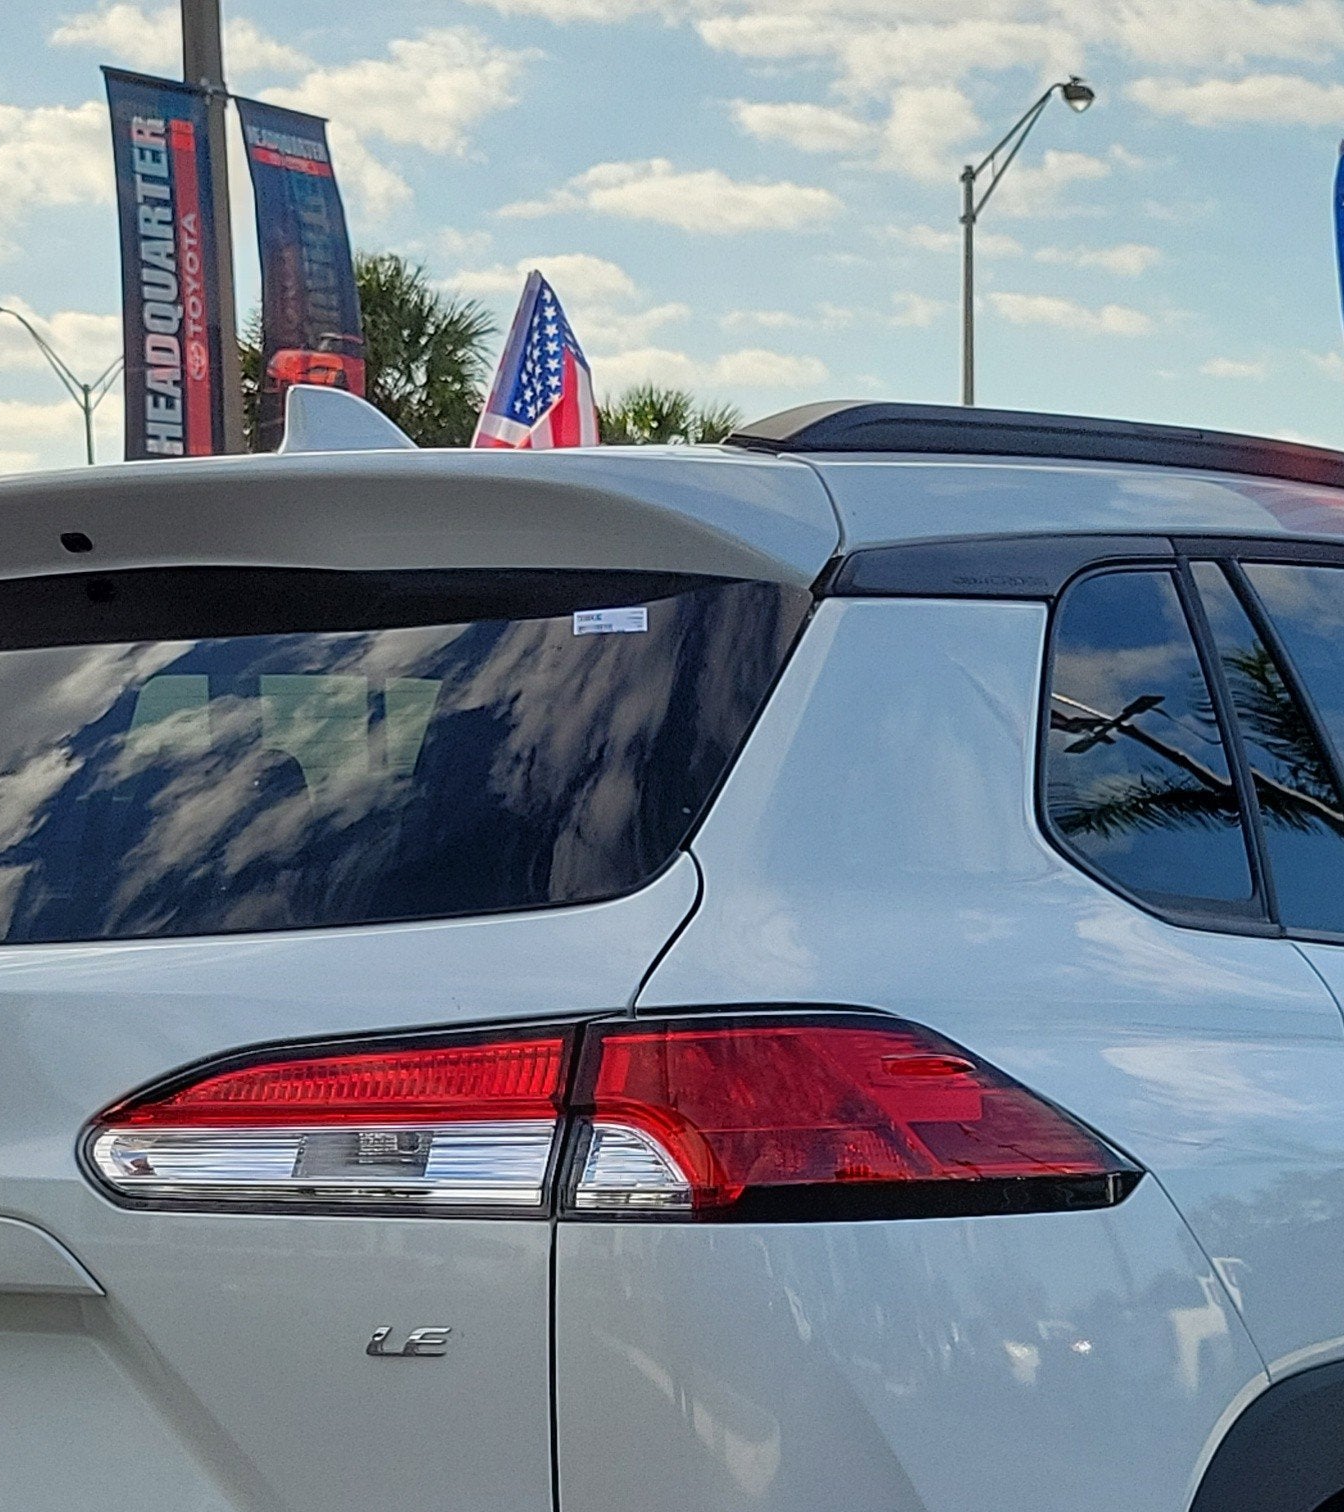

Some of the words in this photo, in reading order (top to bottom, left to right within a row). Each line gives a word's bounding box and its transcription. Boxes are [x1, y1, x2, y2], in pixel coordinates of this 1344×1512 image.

[130, 115, 184, 455] HEADQUARTER
[180, 212, 203, 336] TOYOTA
[366, 1326, 452, 1357] LE
